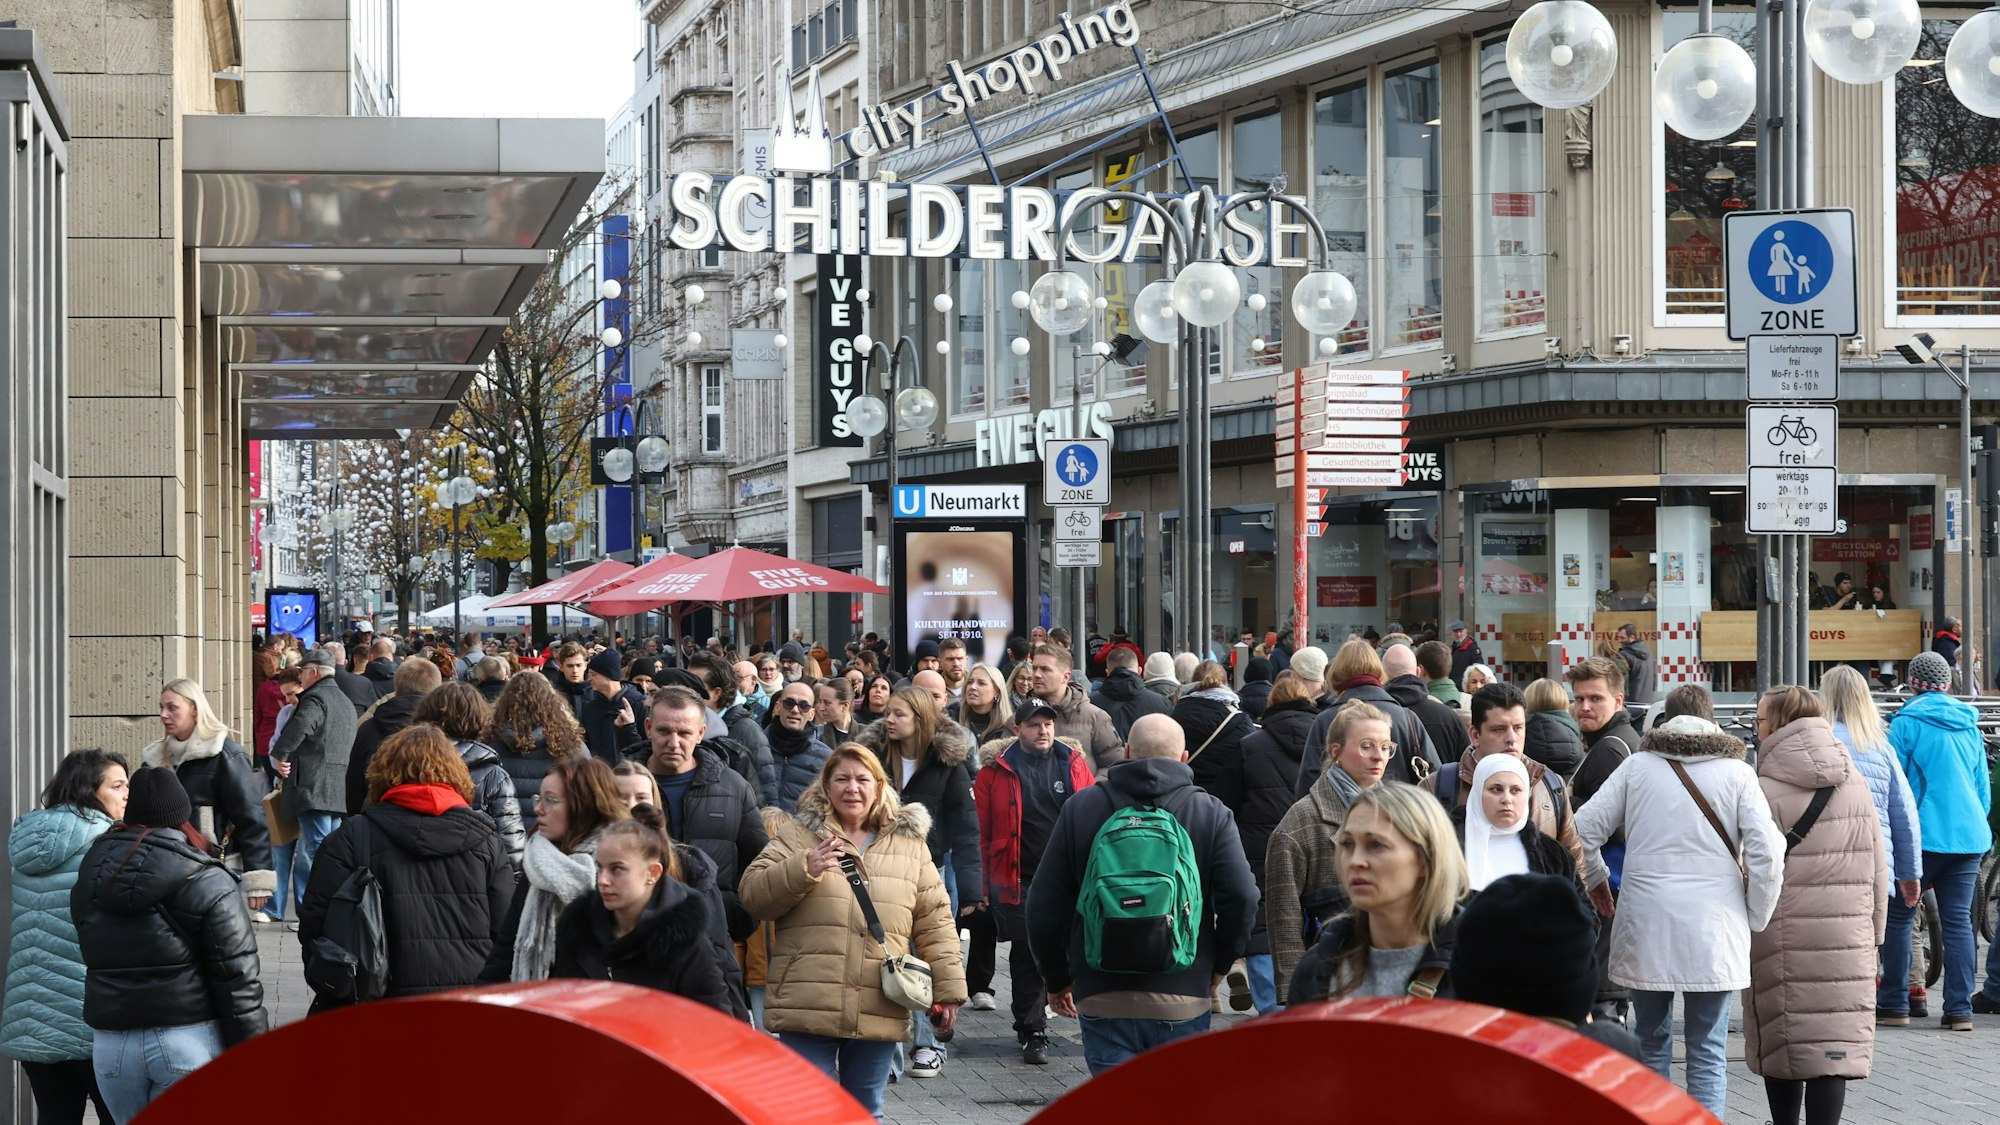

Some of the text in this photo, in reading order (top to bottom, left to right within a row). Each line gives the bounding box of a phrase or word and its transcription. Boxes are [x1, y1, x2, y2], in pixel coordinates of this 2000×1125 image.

[850, 0, 1141, 158] city shopping
[1761, 309, 1825, 331] ZONE
[829, 254, 853, 438] IVE GUYS
[1769, 345, 1823, 355] Lieferfahrzeuge
[735, 346, 781, 362] CHRIST
[1789, 357, 1801, 366] frei
[1331, 372, 1373, 381] Pantaleon
[1771, 370, 1791, 379] Mo-Fr
[1794, 370, 1799, 379] 6
[1805, 370, 1813, 379] 11
[1814, 370, 1819, 379] h
[1781, 382, 1790, 391] Sa
[1793, 382, 1798, 391] 6
[1804, 382, 1812, 391] 10
[1813, 382, 1818, 391] h
[1327, 390, 1368, 400] grippabad
[1356, 406, 1401, 417] Schnütgen
[975, 413, 1036, 468] FIVE
[1324, 440, 1387, 450] Stadtbibliothek
[1322, 457, 1392, 467] Gesundheitsamt
[1779, 450, 1806, 465] frei
[1323, 474, 1392, 485] Rautenstrauch-Joest
[1776, 471, 1809, 484] werktags
[1061, 489, 1093, 500] ZONE
[898, 489, 1020, 515] U Neumarkt
[1071, 529, 1086, 537] frei
[1483, 537, 1507, 545] Brown
[1507, 537, 1528, 547] Paper
[1831, 542, 1882, 550] RECYCLING
[1838, 550, 1876, 558] STATION
[657, 573, 709, 584] FIVE
[749, 567, 810, 580] FIVE
[757, 575, 829, 590] GUYS
[637, 583, 696, 594] GUYS
[914, 620, 1008, 629] KULTURHANDWERK
[938, 630, 983, 639] SEIT 1910.
[1514, 632, 1545, 641] FIVE GUYS
[1637, 631, 1657, 641] UYS
[1809, 630, 1846, 640] GUYS
